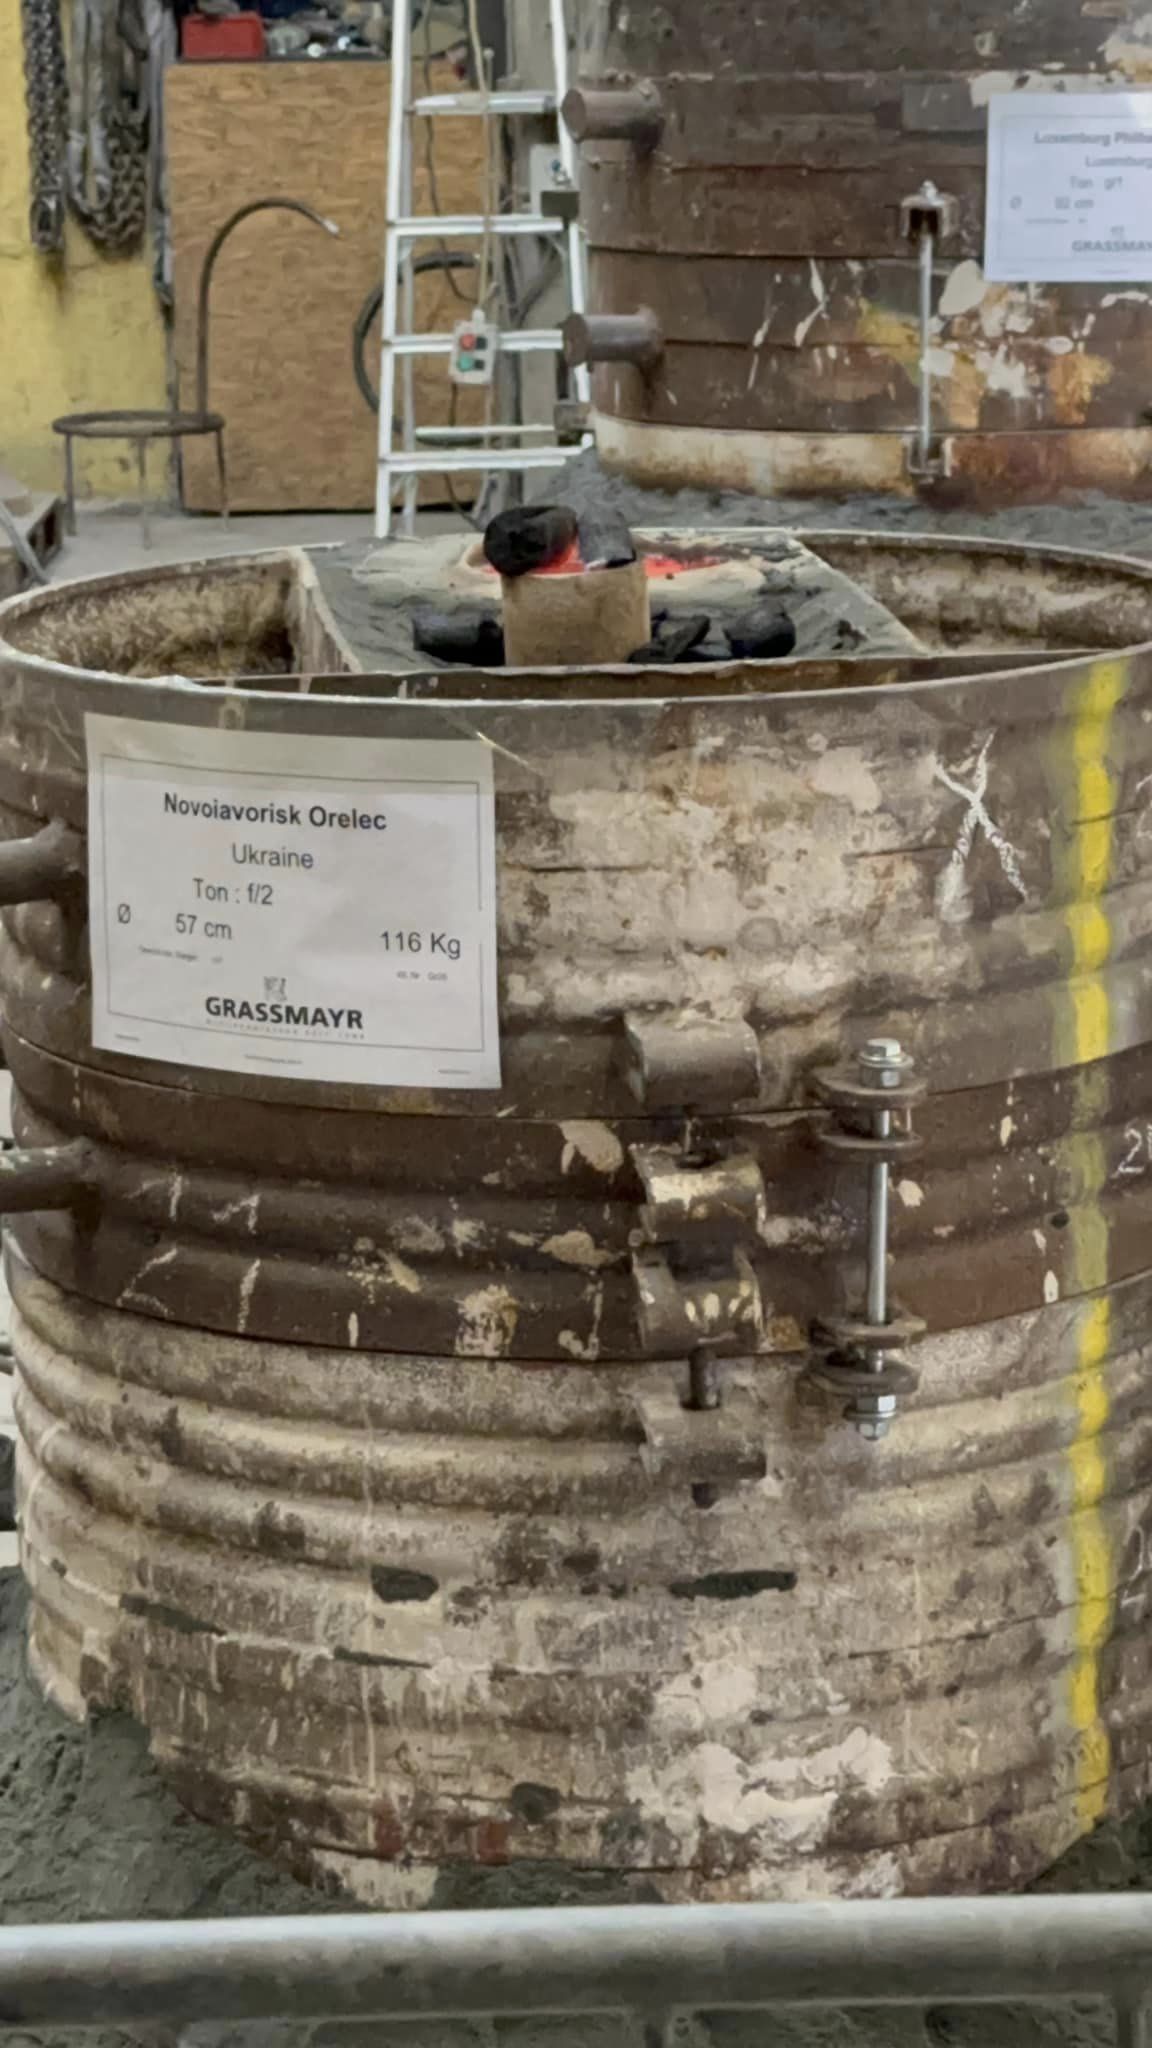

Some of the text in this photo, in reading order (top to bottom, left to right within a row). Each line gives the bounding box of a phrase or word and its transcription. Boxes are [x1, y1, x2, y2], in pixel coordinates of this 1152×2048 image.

[164, 792, 387, 830] Novoiavorisk Orelec
[232, 843, 313, 869] Ukraine
[193, 878, 229, 902] Ton
[247, 882, 273, 905] f/2
[175, 913, 197, 935] 57
[204, 921, 232, 940] cm
[380, 931, 461, 960] 116 Kg
[205, 996, 363, 1029] GRASSMAYR
